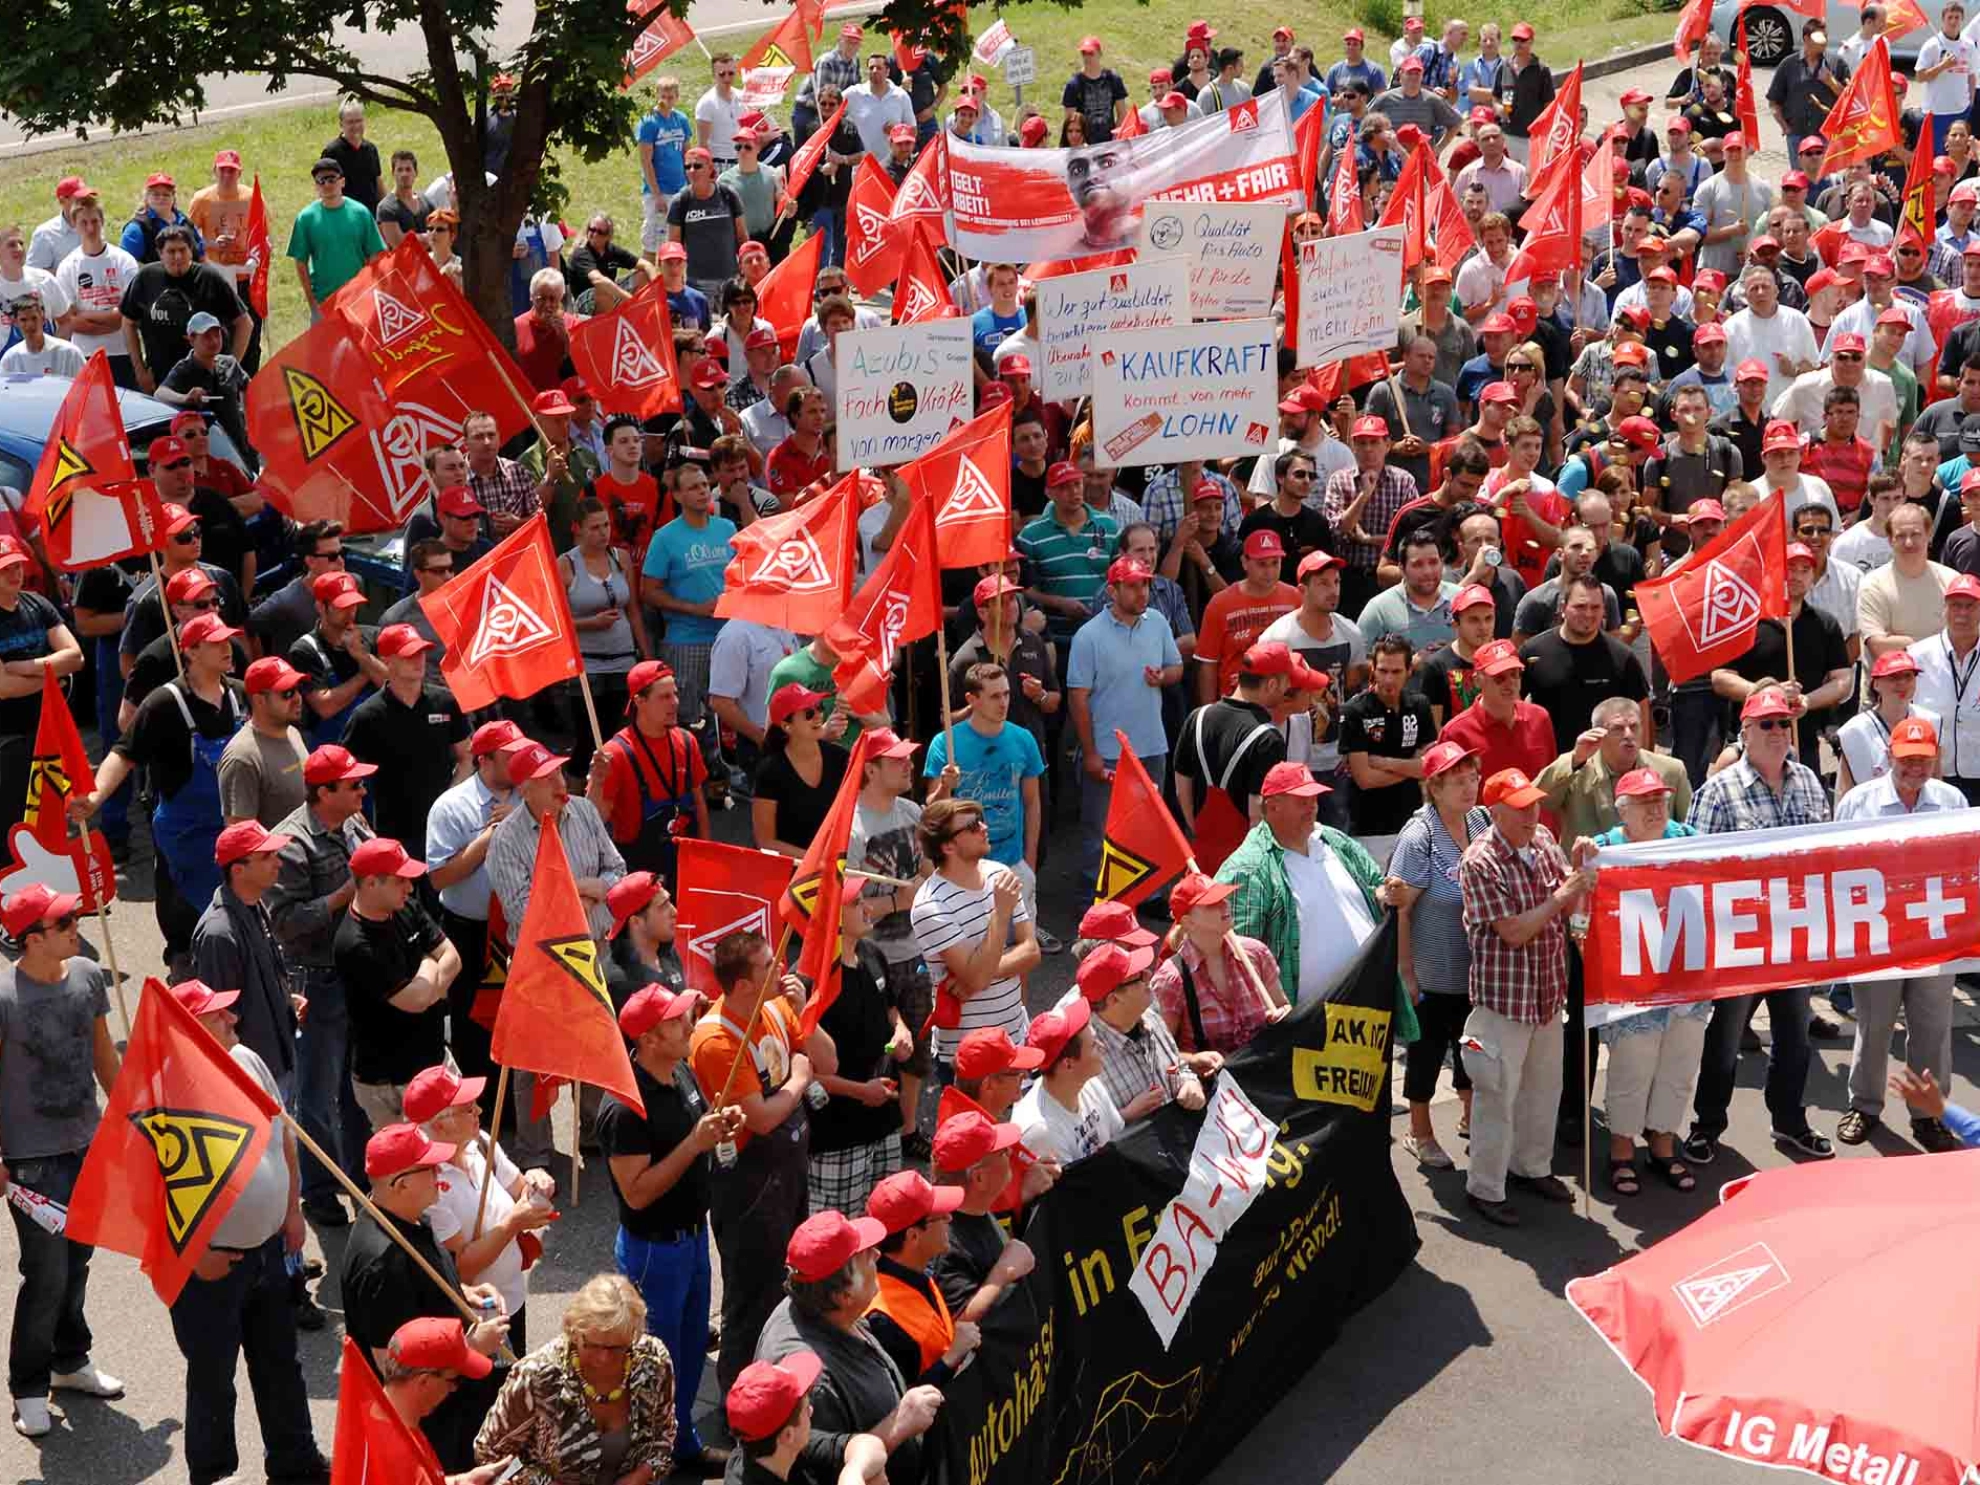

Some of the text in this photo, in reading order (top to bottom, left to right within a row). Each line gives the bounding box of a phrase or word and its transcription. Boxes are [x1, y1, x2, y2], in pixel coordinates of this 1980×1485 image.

[1236, 163, 1289, 199] FAIR
[1228, 241, 1263, 258] Auto
[1082, 290, 1106, 319] gut
[1122, 344, 1271, 381] KAUFKRAFT
[845, 387, 886, 419] Fach
[1190, 390, 1213, 402] von
[1219, 385, 1257, 400] mehr
[1162, 411, 1238, 438] LOHN
[851, 431, 942, 459] von morgen
[1402, 714, 1418, 732] 82
[1620, 868, 1890, 976] MEHR
[1064, 1249, 1115, 1316] in
[1723, 1410, 1921, 1485] IG Metall
